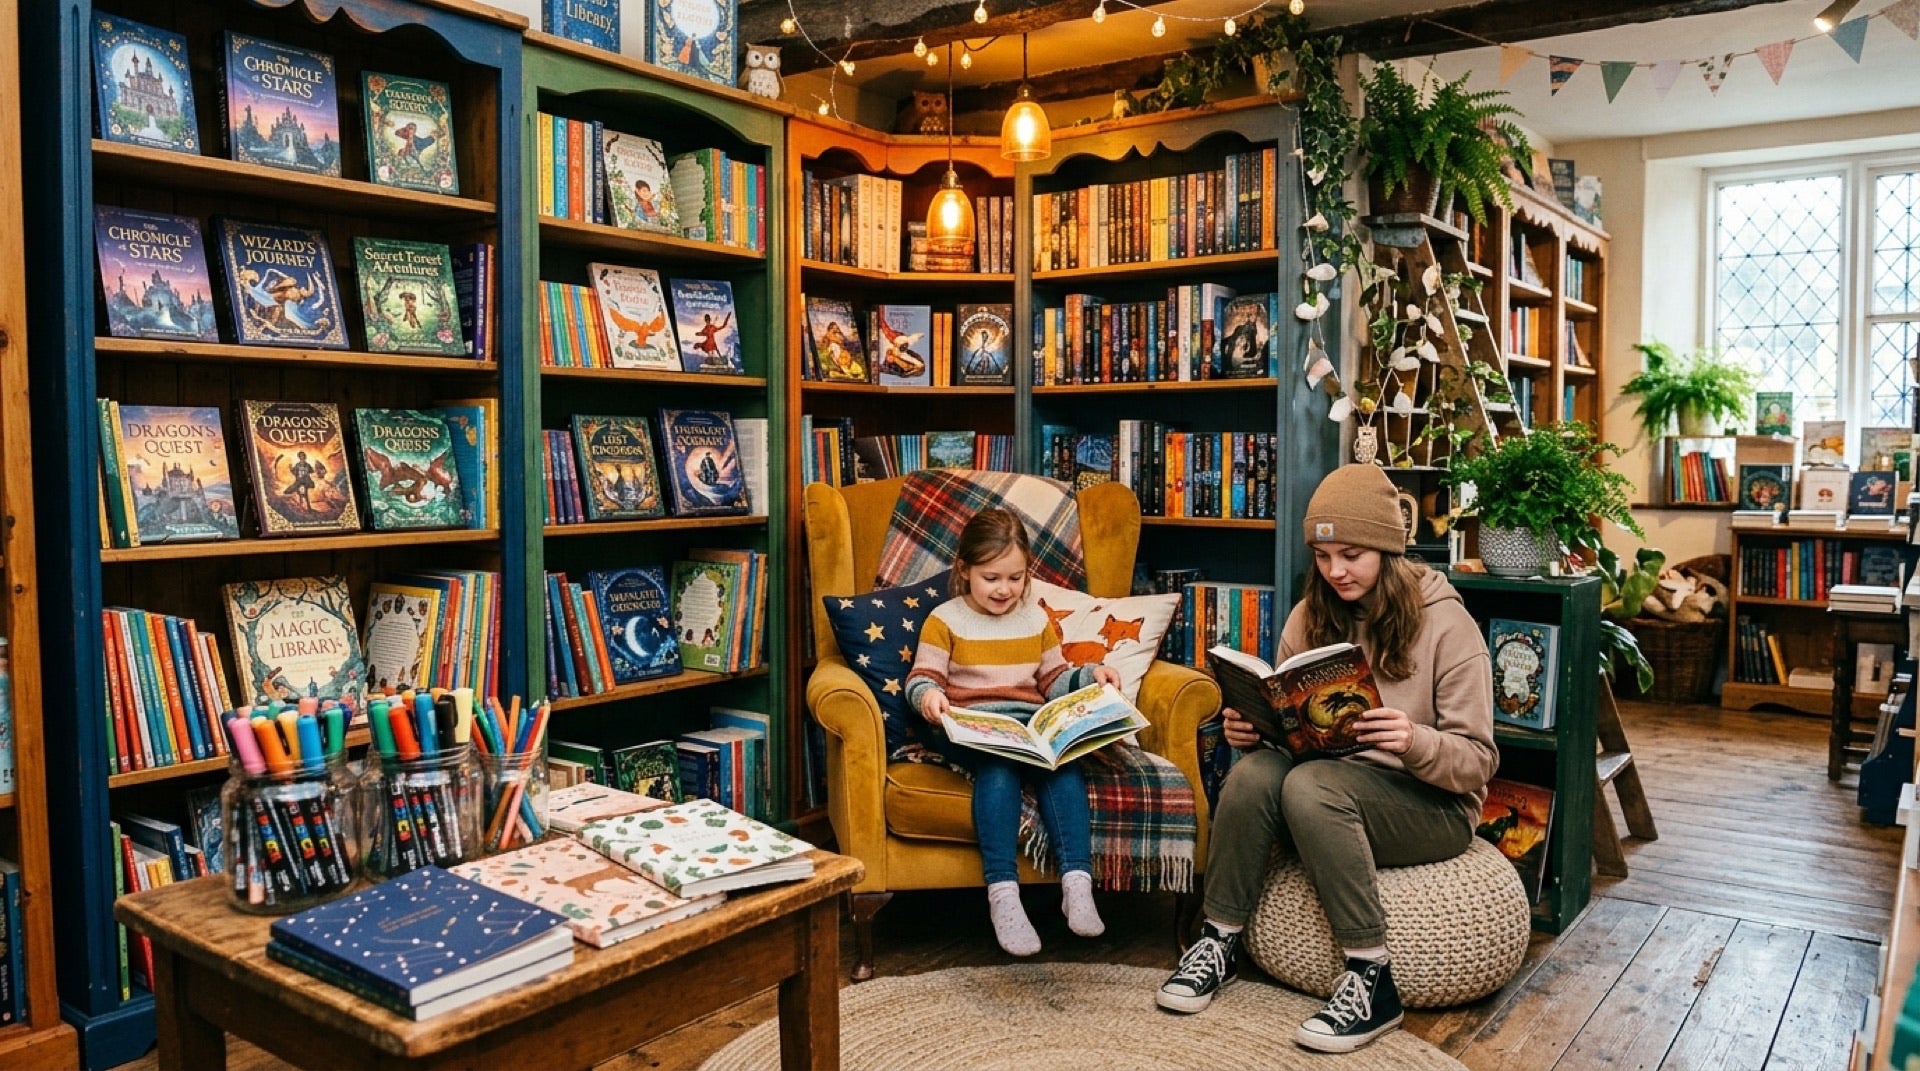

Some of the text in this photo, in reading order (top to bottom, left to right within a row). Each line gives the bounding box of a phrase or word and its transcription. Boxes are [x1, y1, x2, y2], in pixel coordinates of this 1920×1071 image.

[261, 73, 313, 99] STARS
[108, 226, 192, 248] CHRONICLE
[240, 234, 316, 255] WIZARD'S
[129, 242, 183, 263] STARS
[269, 428, 327, 446] QUEST
[144, 439, 203, 458] QUEST
[270, 617, 331, 639] MAGIC
[270, 636, 343, 659] LIBRARY
